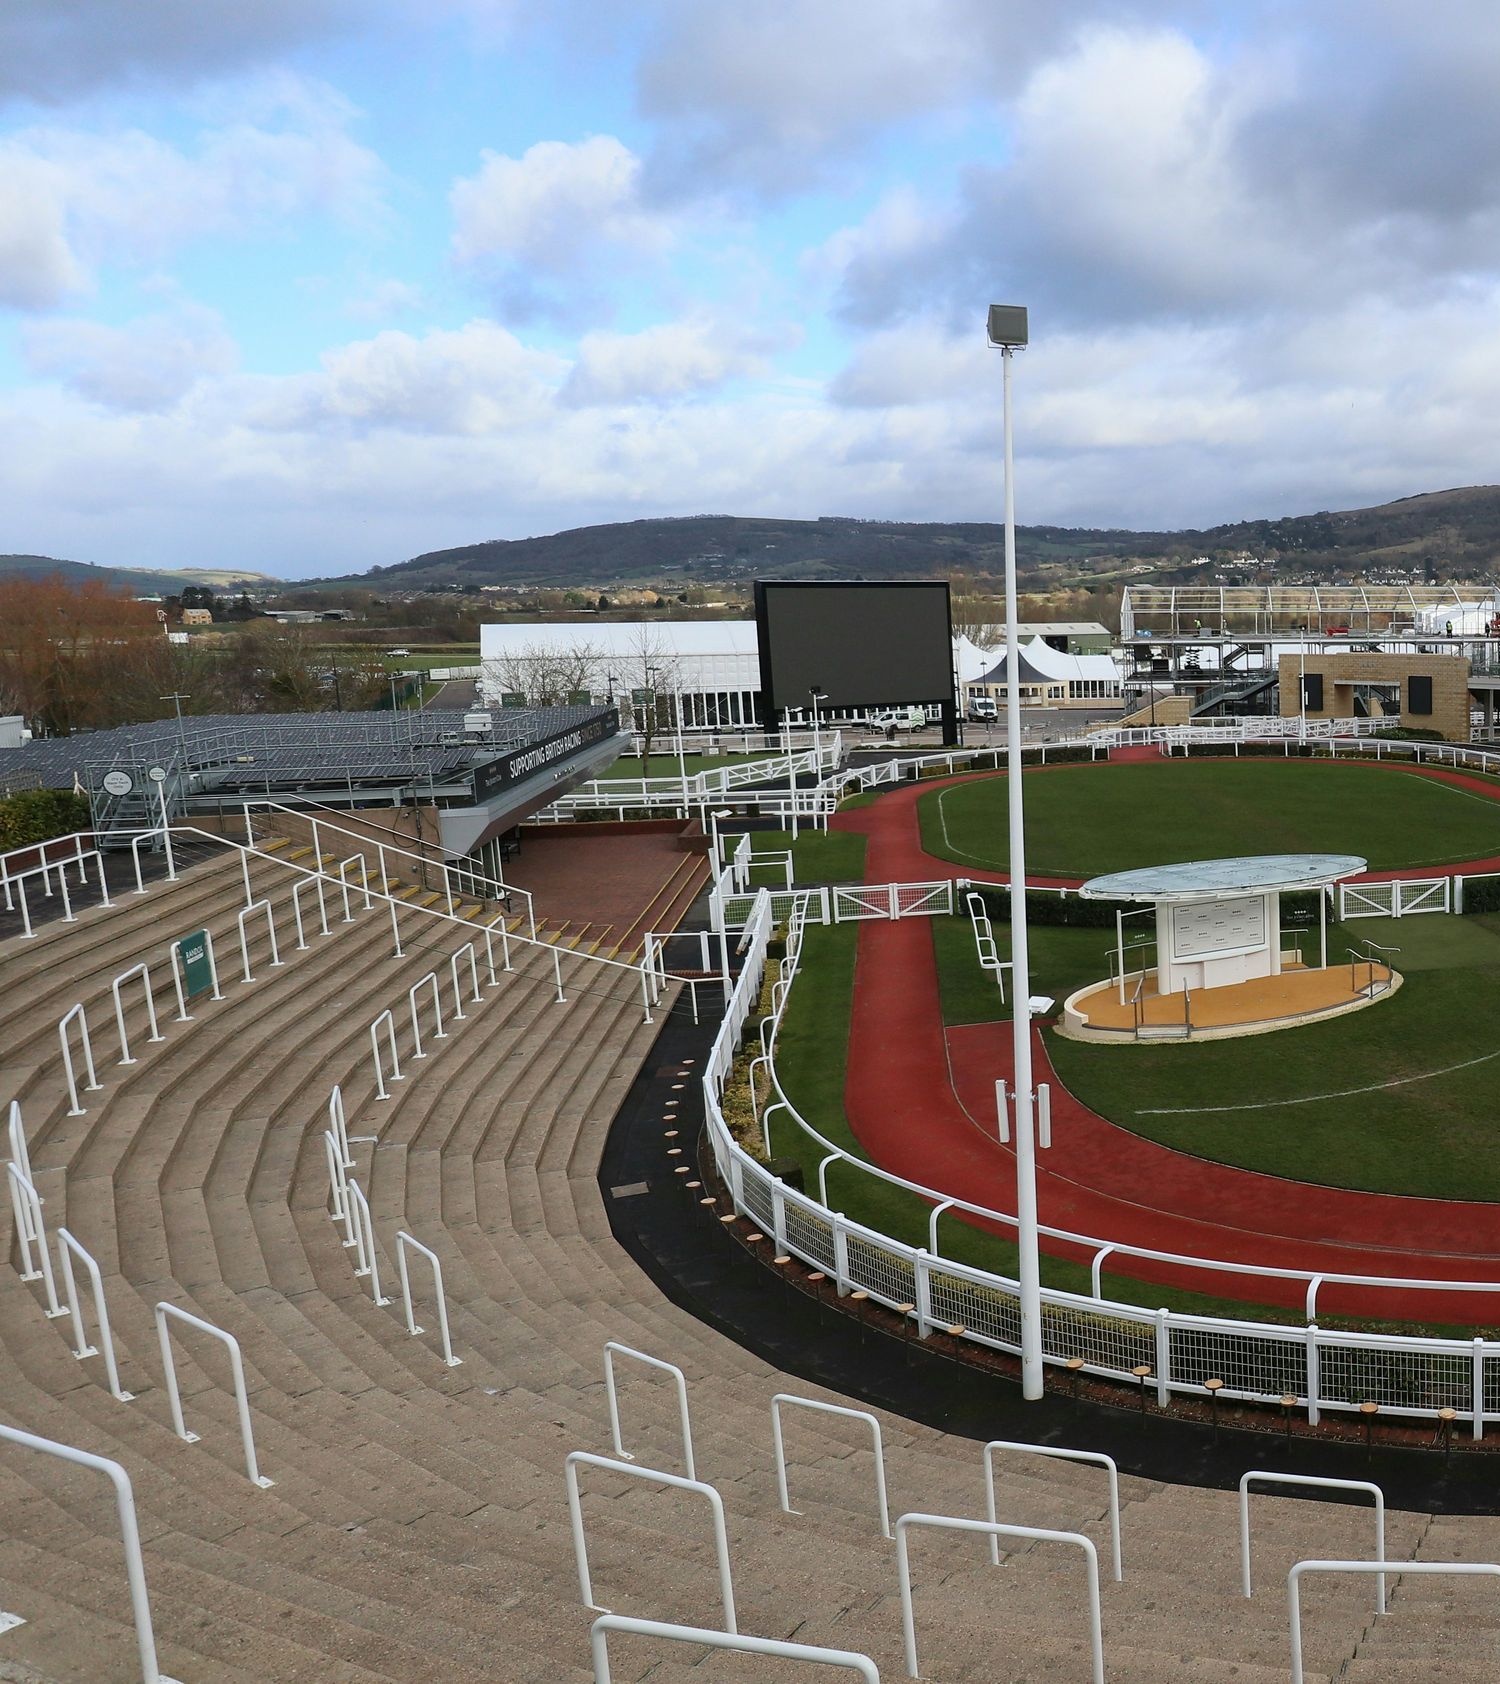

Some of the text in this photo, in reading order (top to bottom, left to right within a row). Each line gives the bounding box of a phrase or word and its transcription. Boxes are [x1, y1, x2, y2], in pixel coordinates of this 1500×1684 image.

[509, 746, 545, 779] SUPPORTING
[545, 738, 565, 761] BRITISH
[564, 730, 581, 752] RACING
